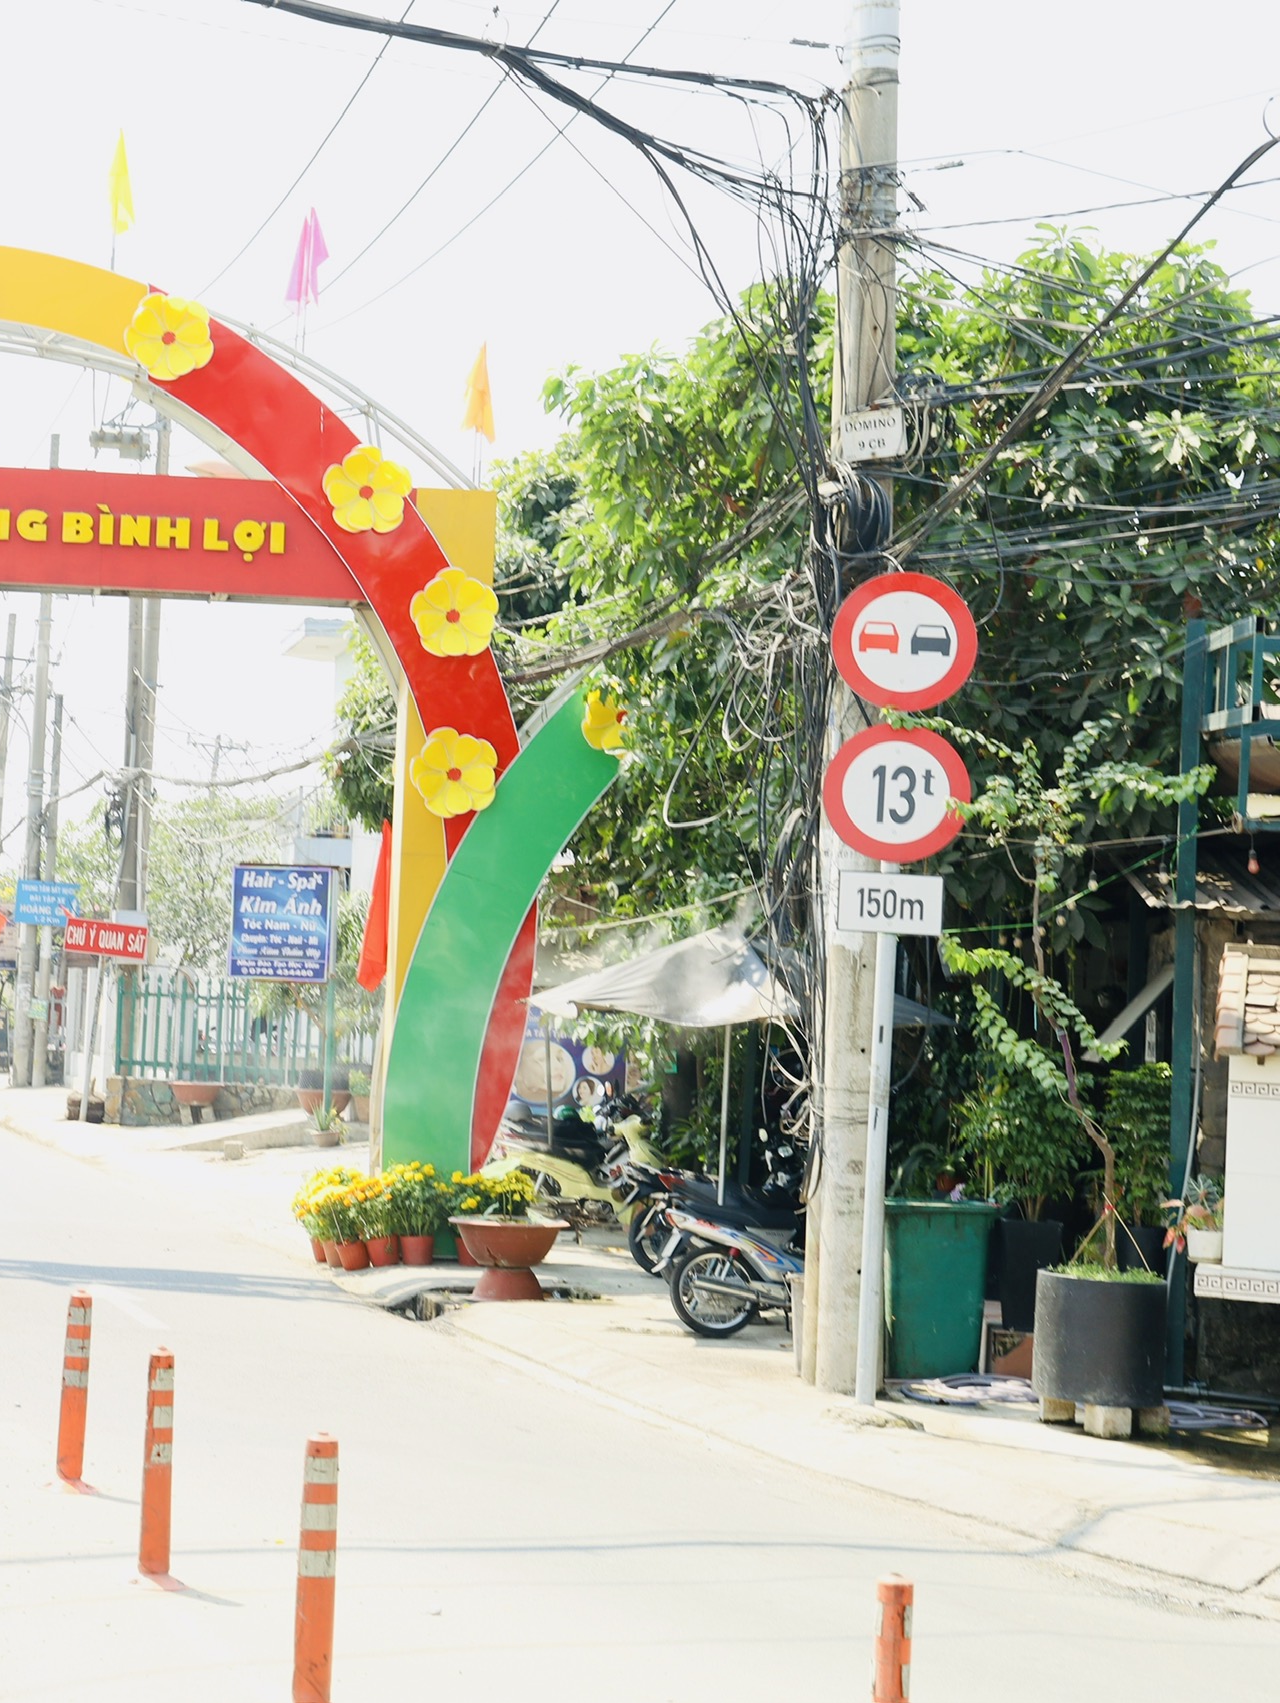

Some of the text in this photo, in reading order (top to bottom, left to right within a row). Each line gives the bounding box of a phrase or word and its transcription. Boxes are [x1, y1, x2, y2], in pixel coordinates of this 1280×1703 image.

[844, 417, 896, 433] DOMINO
[858, 440, 866, 451] 9
[61, 503, 191, 549] BÌNH
[202, 518, 286, 562] LỢI
[242, 871, 317, 892] Hair Spa
[240, 895, 278, 914] Kim
[857, 888, 924, 921] 150m
[242, 918, 263, 930] Tóc
[264, 919, 290, 931] Nam
[99, 929, 125, 951] QUAN
[127, 929, 146, 953] SÁT
